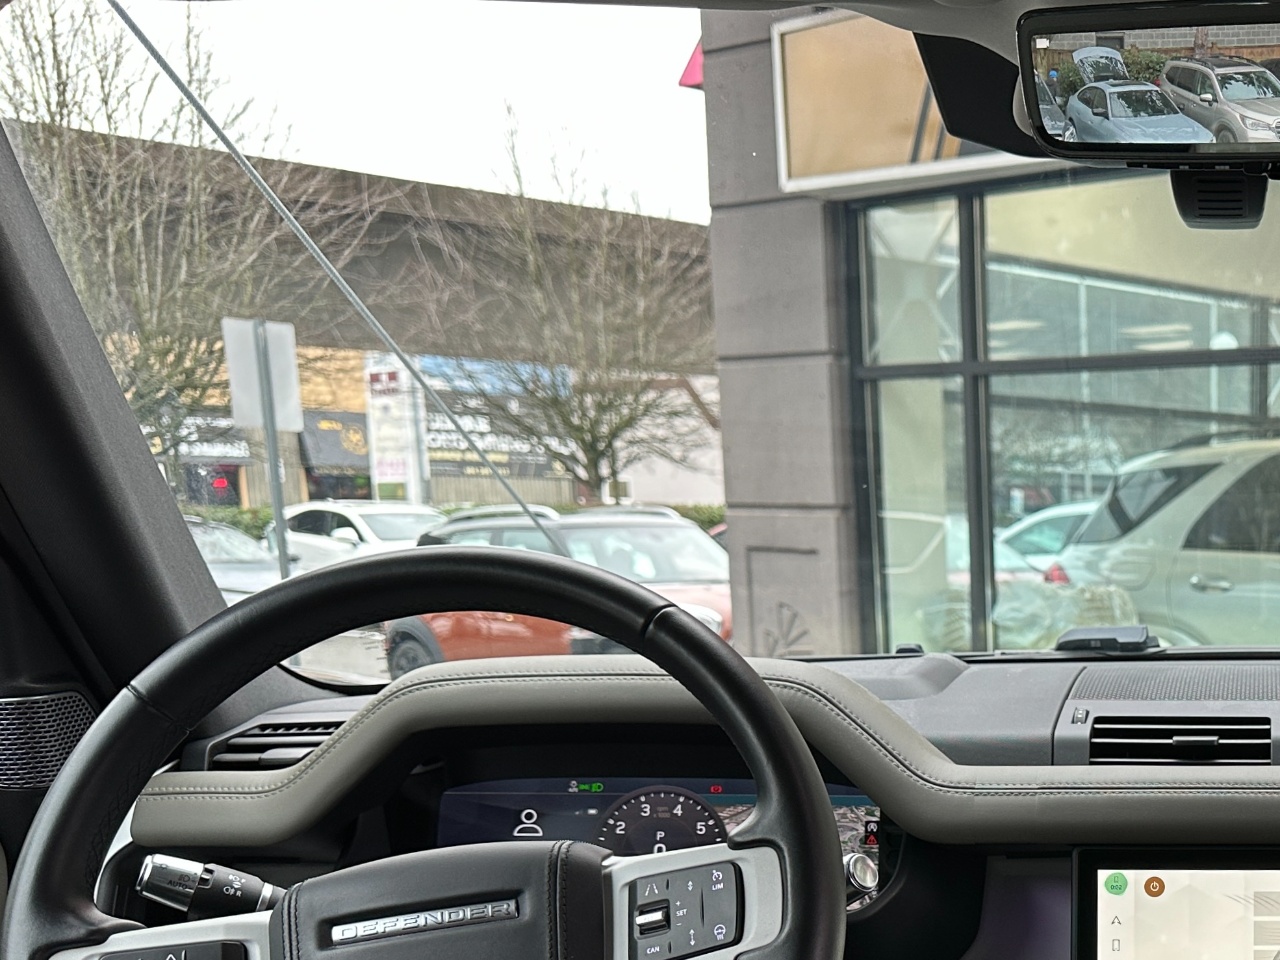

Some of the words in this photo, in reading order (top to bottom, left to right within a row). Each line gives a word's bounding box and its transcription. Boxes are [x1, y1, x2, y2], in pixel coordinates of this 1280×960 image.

[640, 804, 651, 817] 3
[672, 804, 683, 817] 4
[615, 821, 626, 835] 2
[695, 822, 706, 835] 5
[656, 831, 665, 841] P
[167, 879, 188, 890] AUTO
[711, 882, 724, 891] LIM
[676, 908, 687, 917] SET
[339, 901, 512, 941] DEFENDER
[646, 946, 660, 954] CAN
